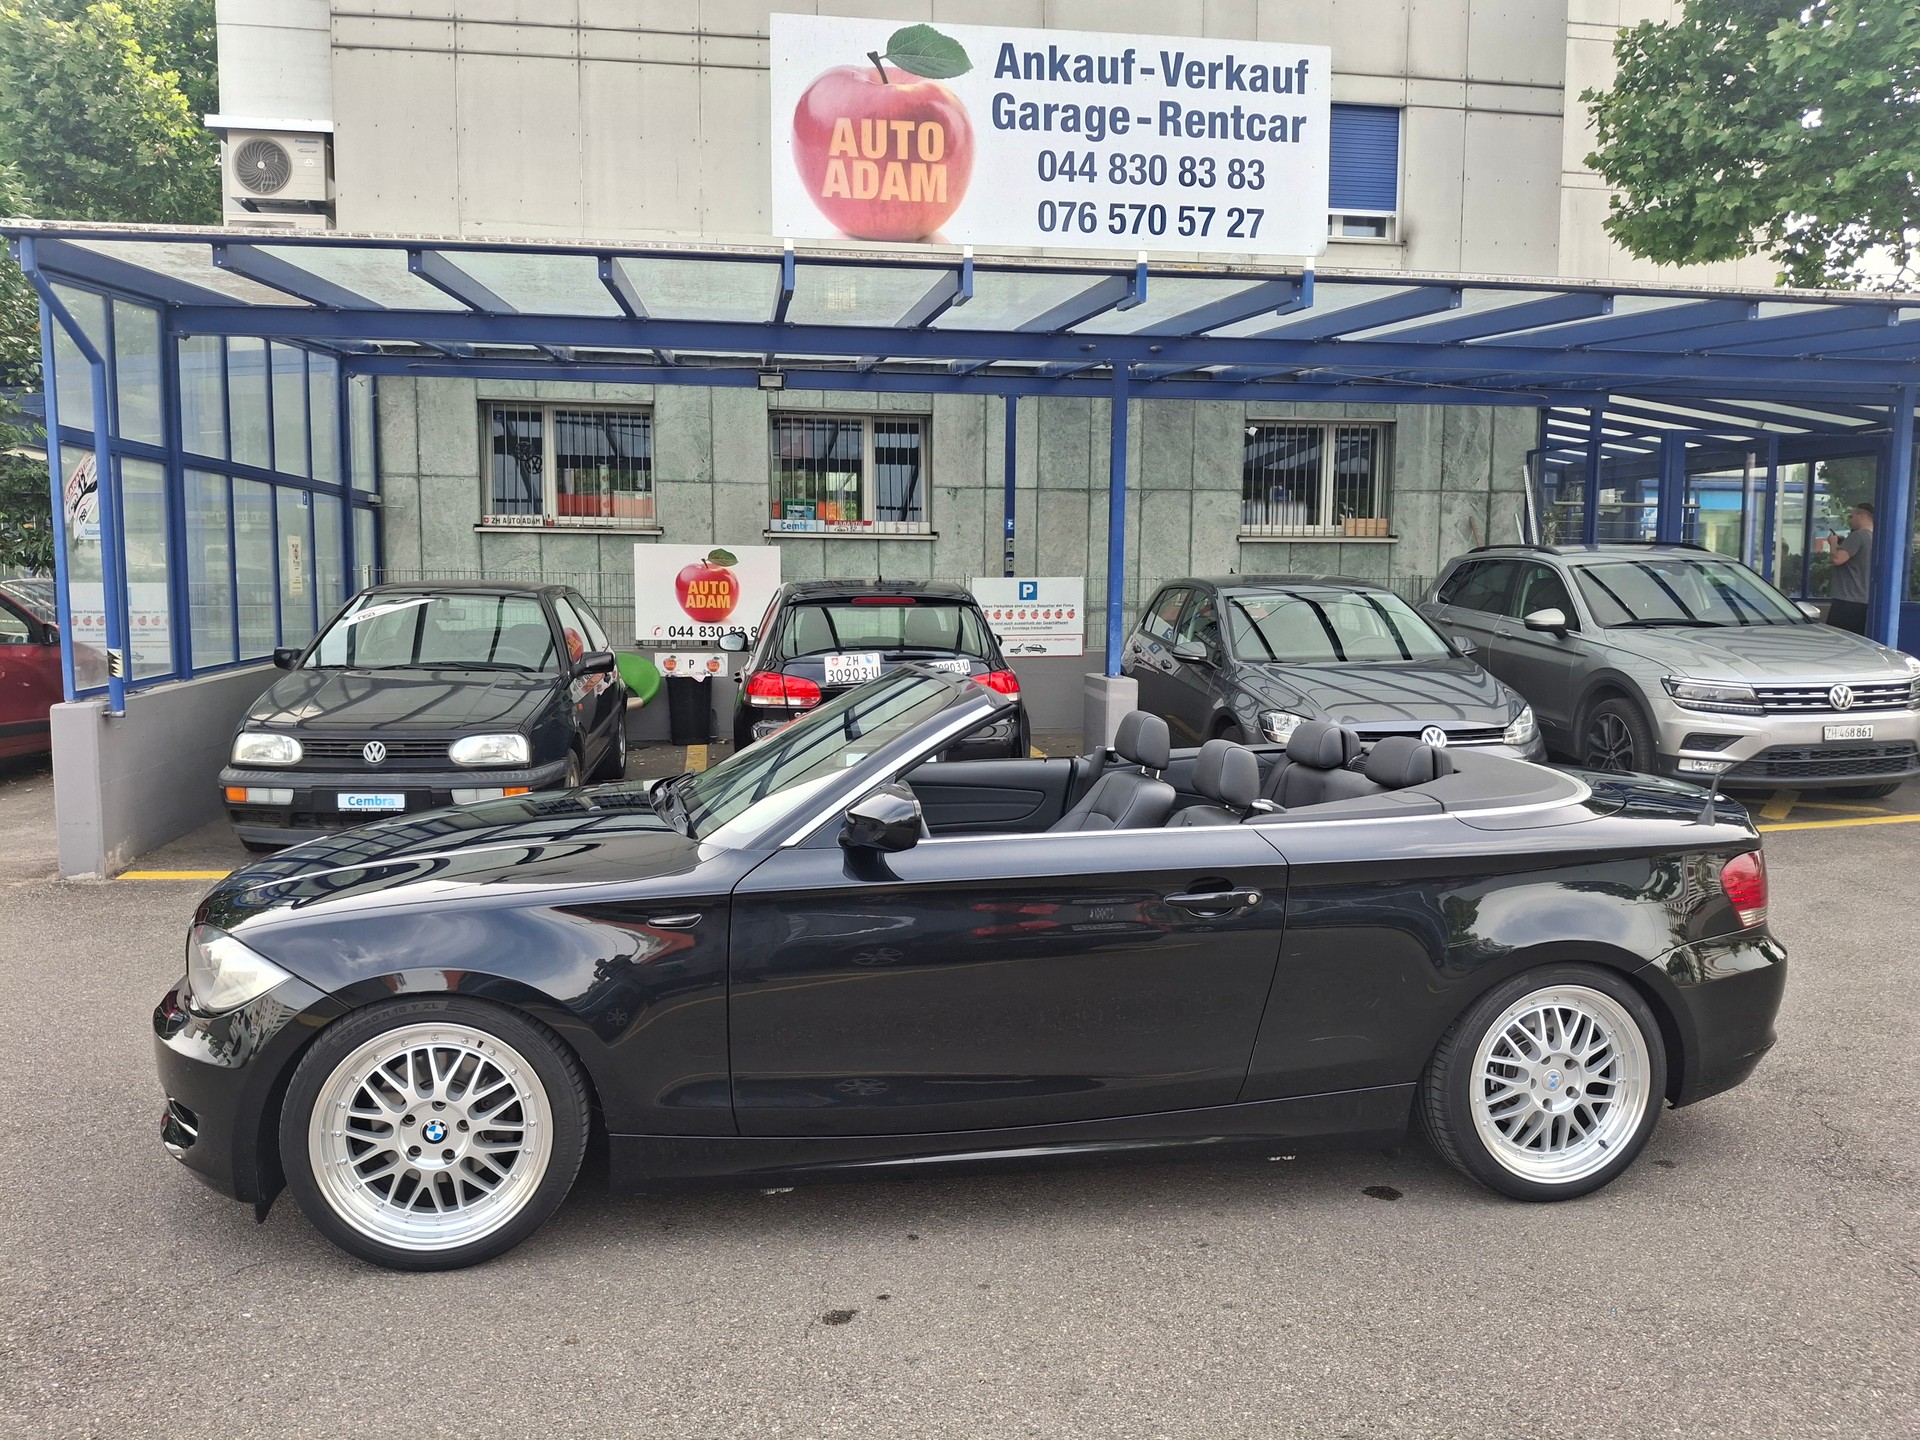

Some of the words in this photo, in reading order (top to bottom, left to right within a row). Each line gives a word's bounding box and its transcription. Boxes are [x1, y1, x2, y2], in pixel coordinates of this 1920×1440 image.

[828, 116, 946, 162] AUTO
[1038, 150, 1098, 184] 044
[1109, 152, 1167, 187] 830
[1178, 155, 1216, 188] 83
[1228, 158, 1265, 190] 83
[822, 159, 947, 203] ADAM
[1038, 200, 1098, 234] 076
[1109, 203, 1166, 236] 570
[1178, 206, 1216, 238] 57
[1226, 208, 1264, 239] 27
[688, 580, 730, 594] AUTO
[1022, 584, 1034, 598] P
[685, 595, 730, 608] ADAM
[668, 626, 694, 638] 044
[699, 626, 724, 638] 830
[750, 626, 758, 638] 8
[689, 660, 694, 669] P
[846, 656, 858, 666] ZH
[348, 796, 396, 806] Cembra
